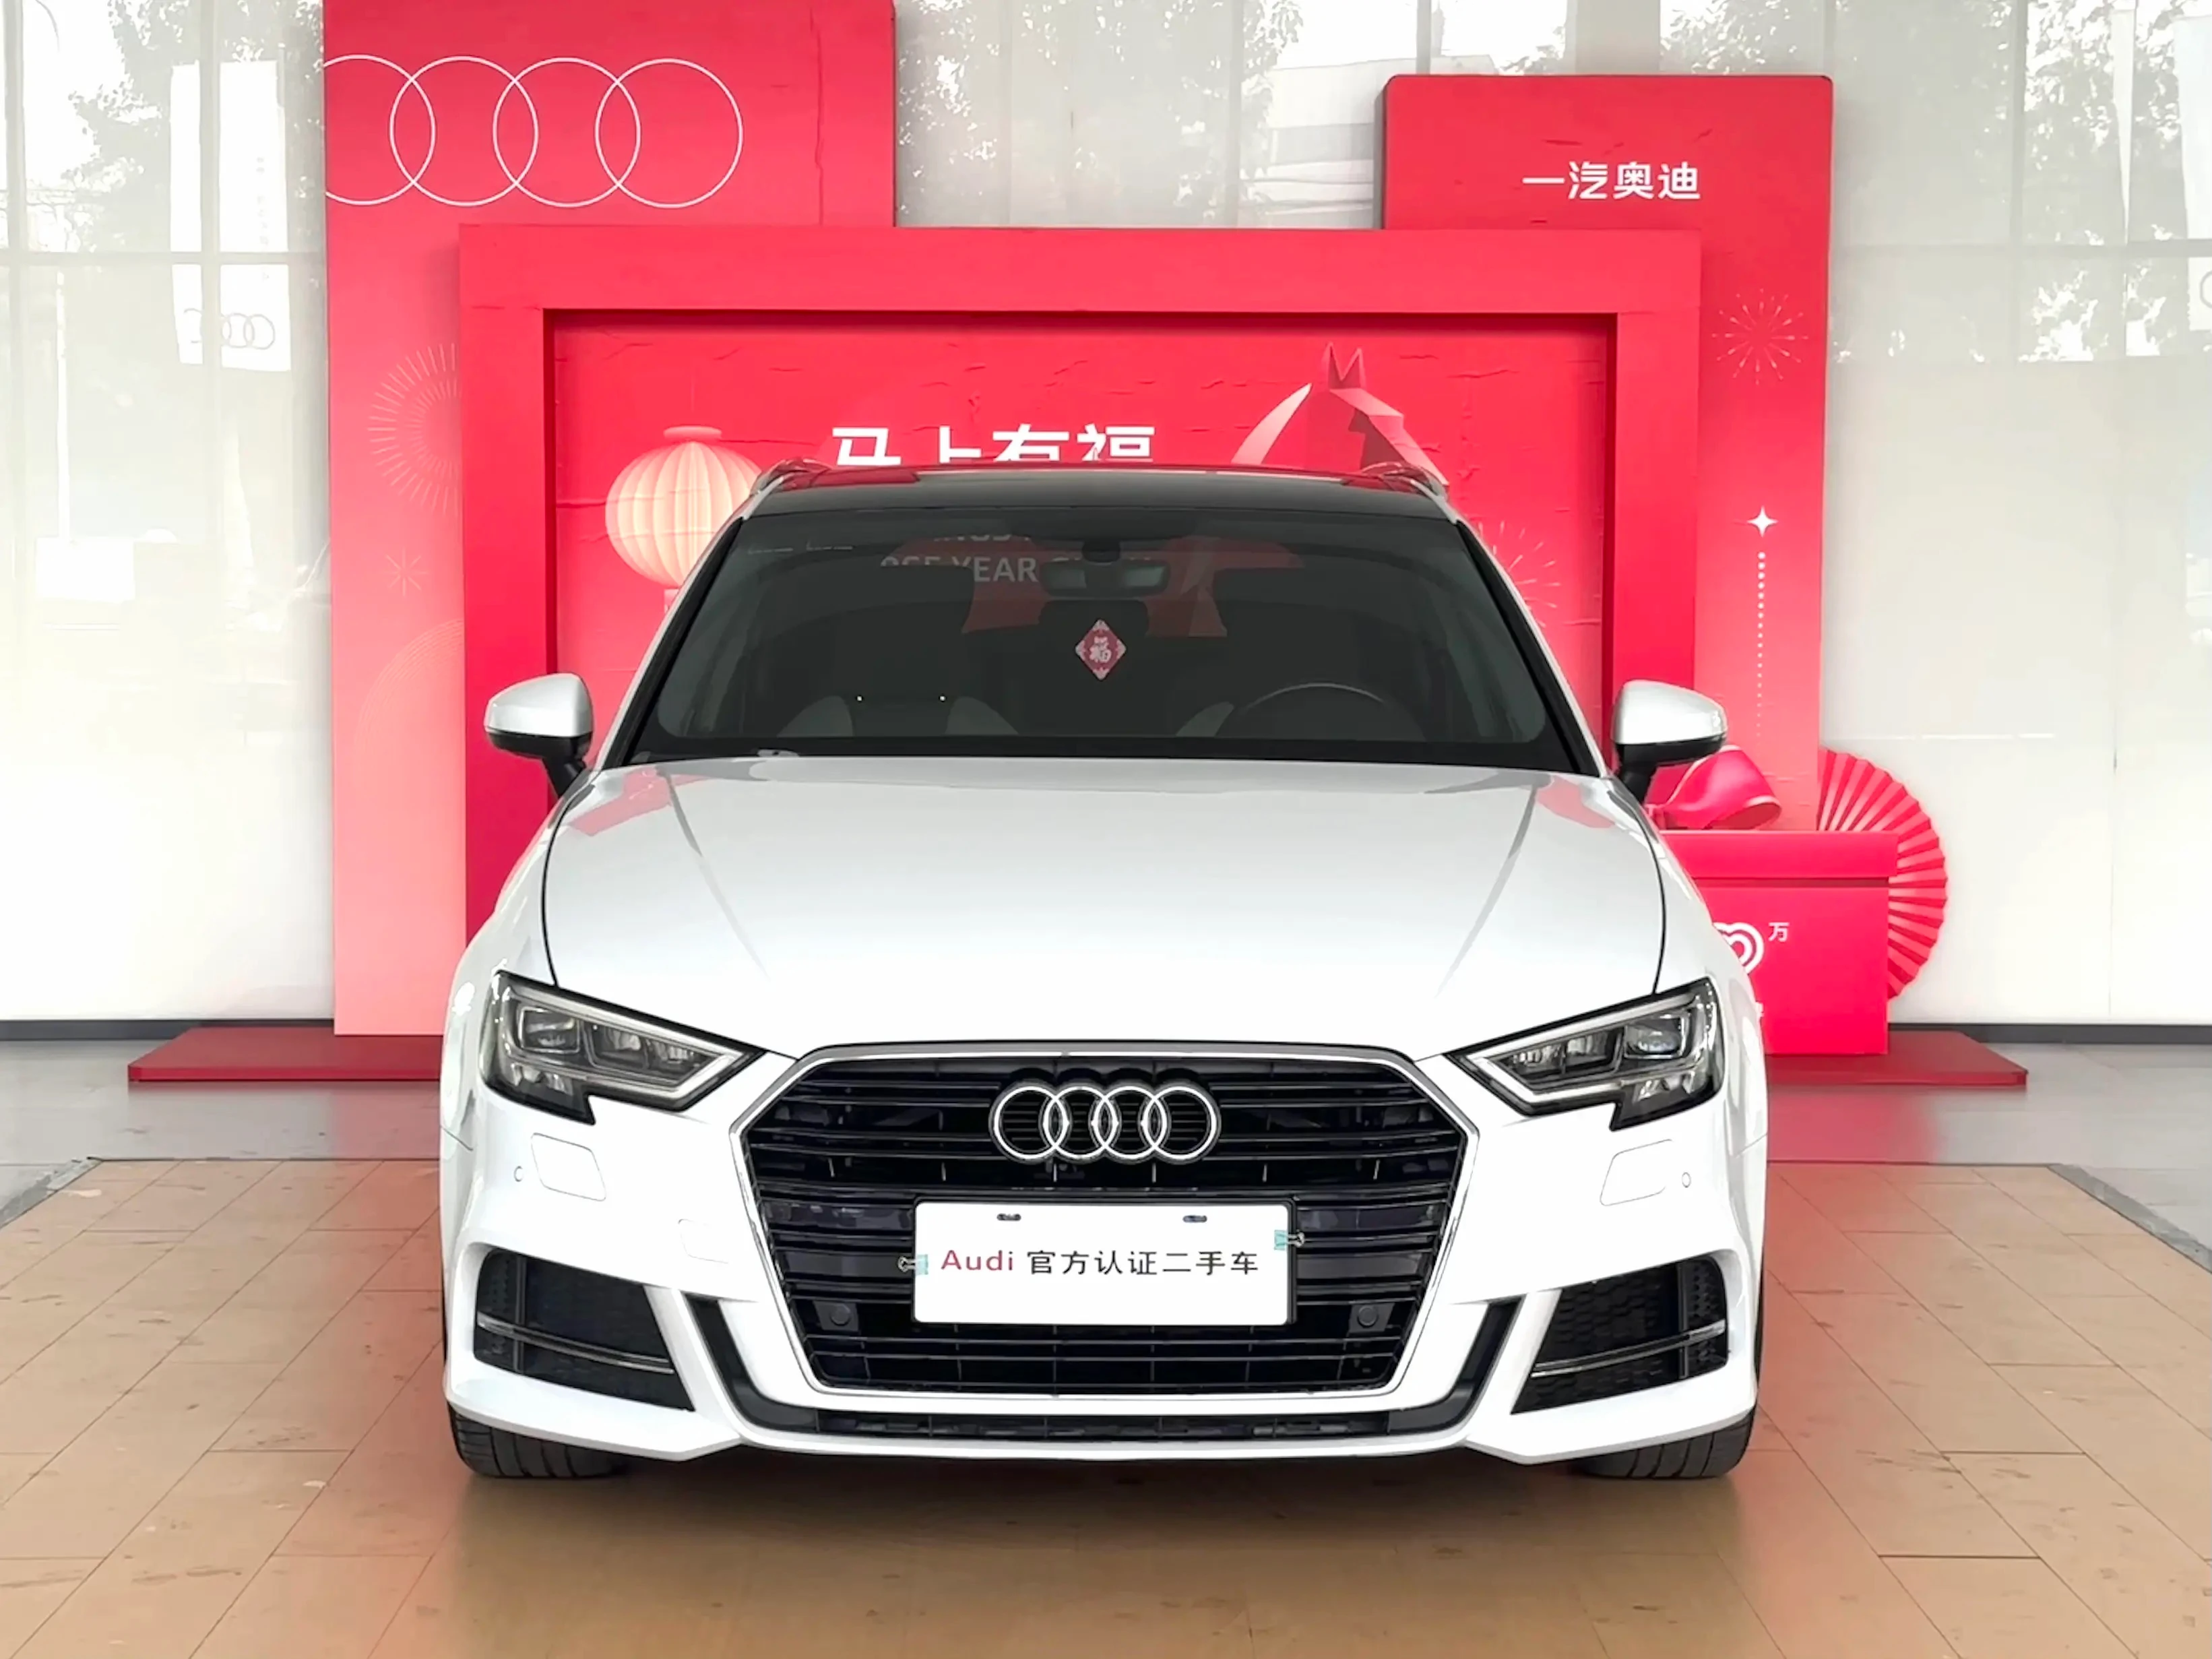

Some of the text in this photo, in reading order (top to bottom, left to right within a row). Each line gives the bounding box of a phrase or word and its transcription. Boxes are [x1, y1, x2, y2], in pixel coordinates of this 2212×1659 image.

[1522, 161, 1700, 199] 一汽奥迪
[941, 1249, 1259, 1276] Audi 官方认证二手车
